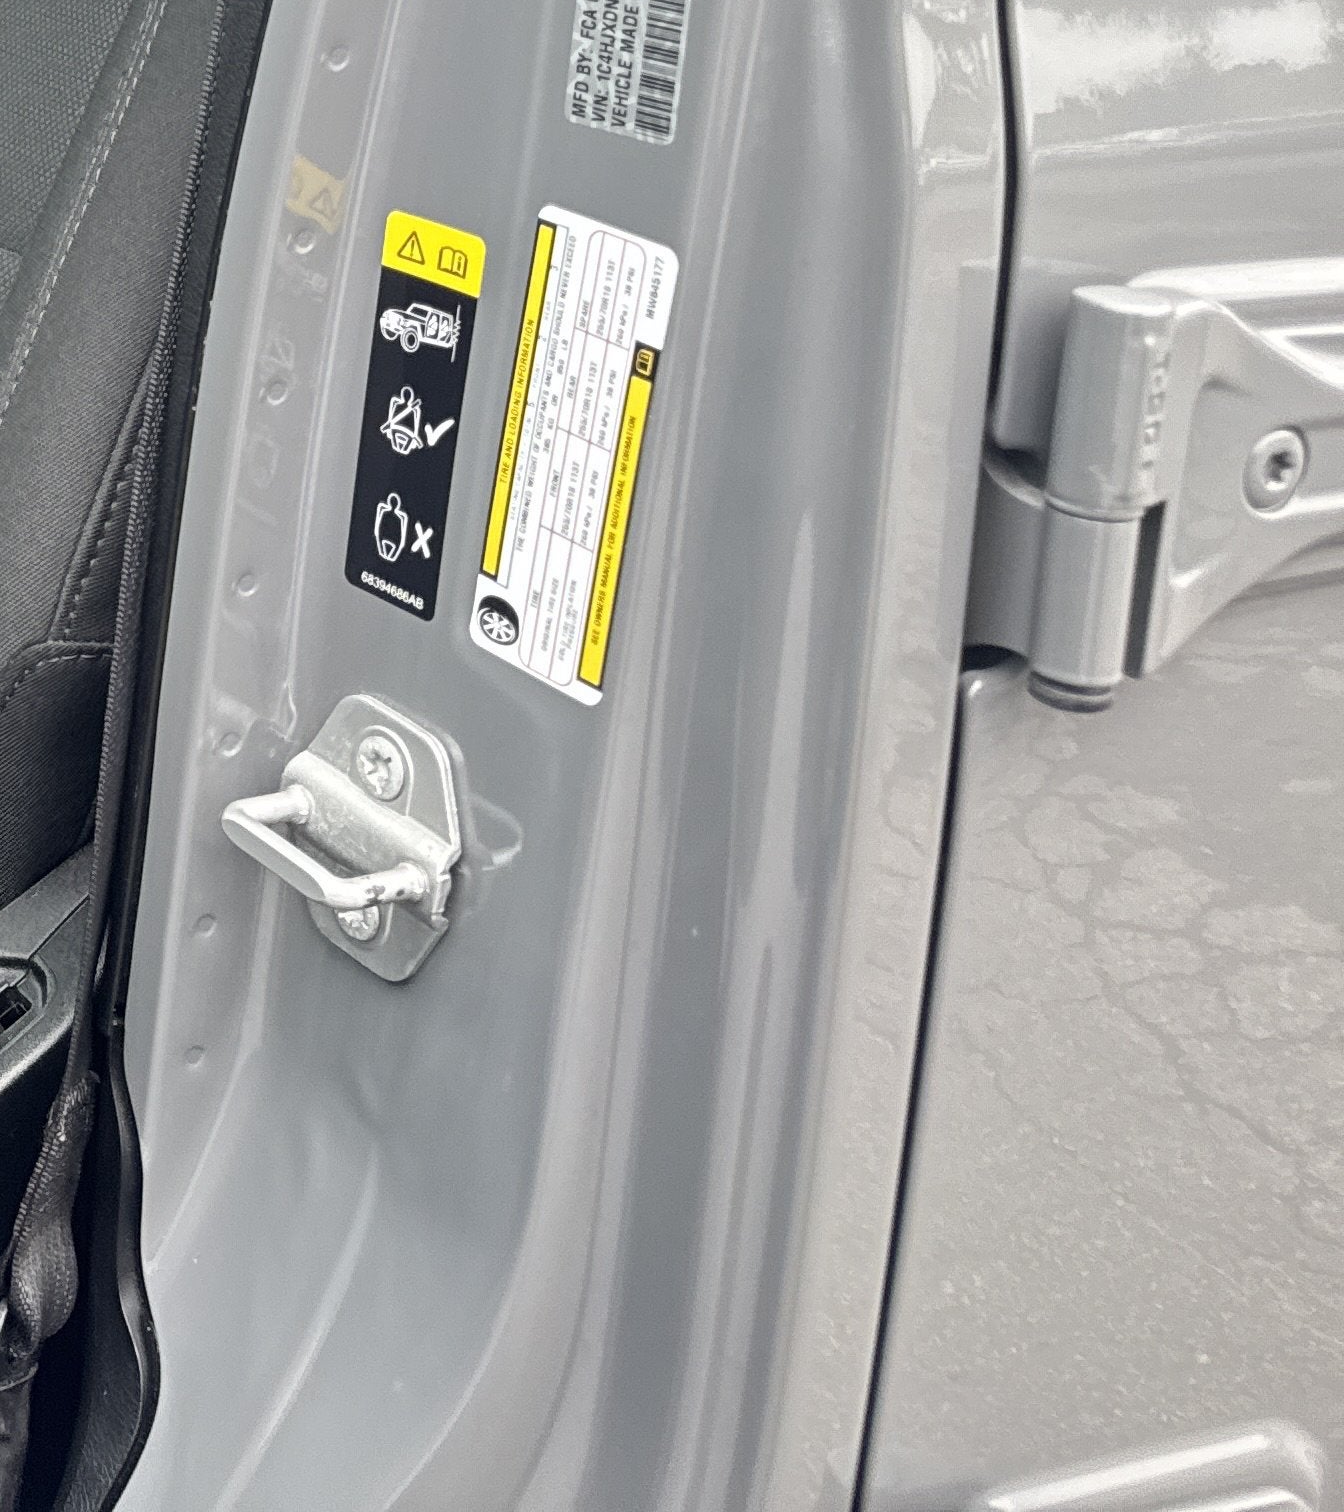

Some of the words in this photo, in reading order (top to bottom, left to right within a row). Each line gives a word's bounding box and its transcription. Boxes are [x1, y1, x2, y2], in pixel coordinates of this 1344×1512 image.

[579, 7, 597, 40] FCA
[618, 3, 639, 54] MADE
[575, 46, 593, 76] BY:
[571, 79, 590, 118] MFD
[591, 88, 610, 123] VIN:
[610, 58, 633, 128] VEHICLE
[515, 317, 534, 389] INFORMATION
[507, 389, 522, 436] LOADING
[503, 436, 514, 459] AND
[499, 461, 510, 485] TIRE
[609, 477, 626, 530] ADDITIONAL
[619, 414, 637, 477] INFORMATION
